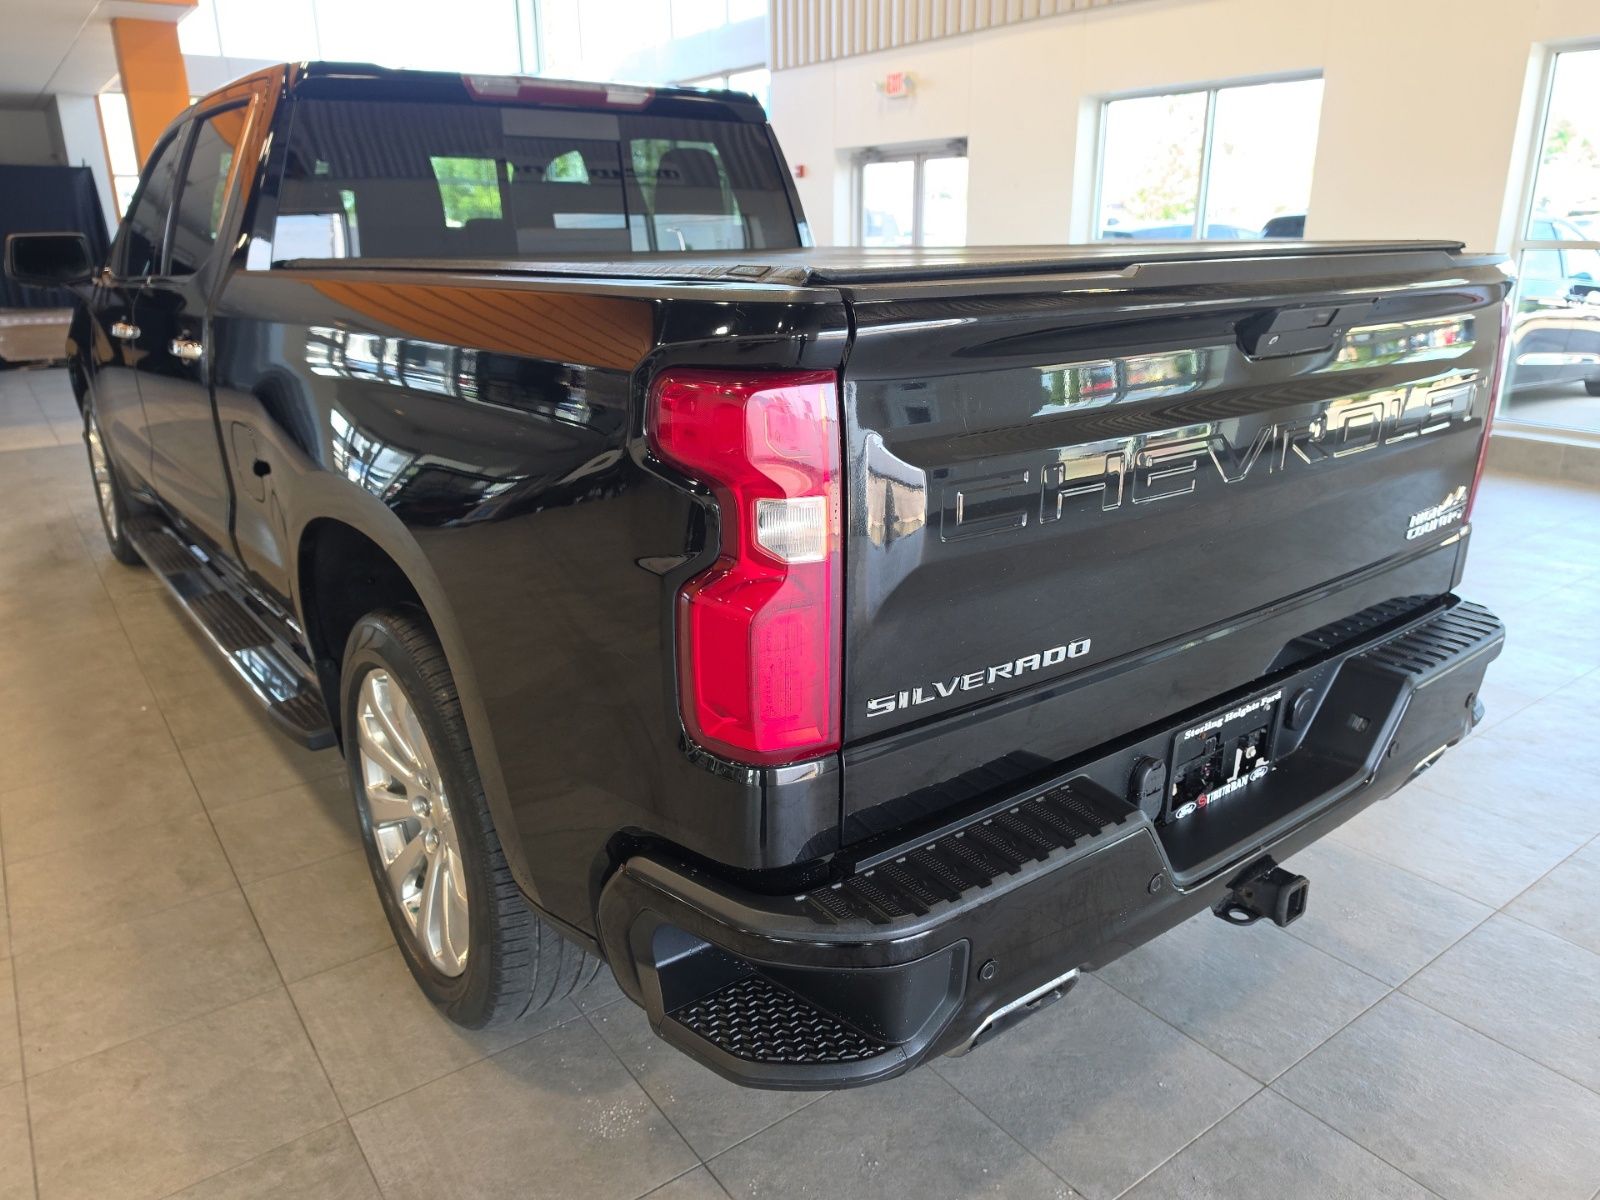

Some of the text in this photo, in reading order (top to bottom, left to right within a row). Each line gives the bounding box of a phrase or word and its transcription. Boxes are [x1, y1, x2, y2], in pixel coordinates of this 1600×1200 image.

[940, 374, 1488, 542] CHEVROLET
[866, 637, 1092, 718] SILVERADO
[1184, 690, 1281, 739] Sterling Heights Ford
